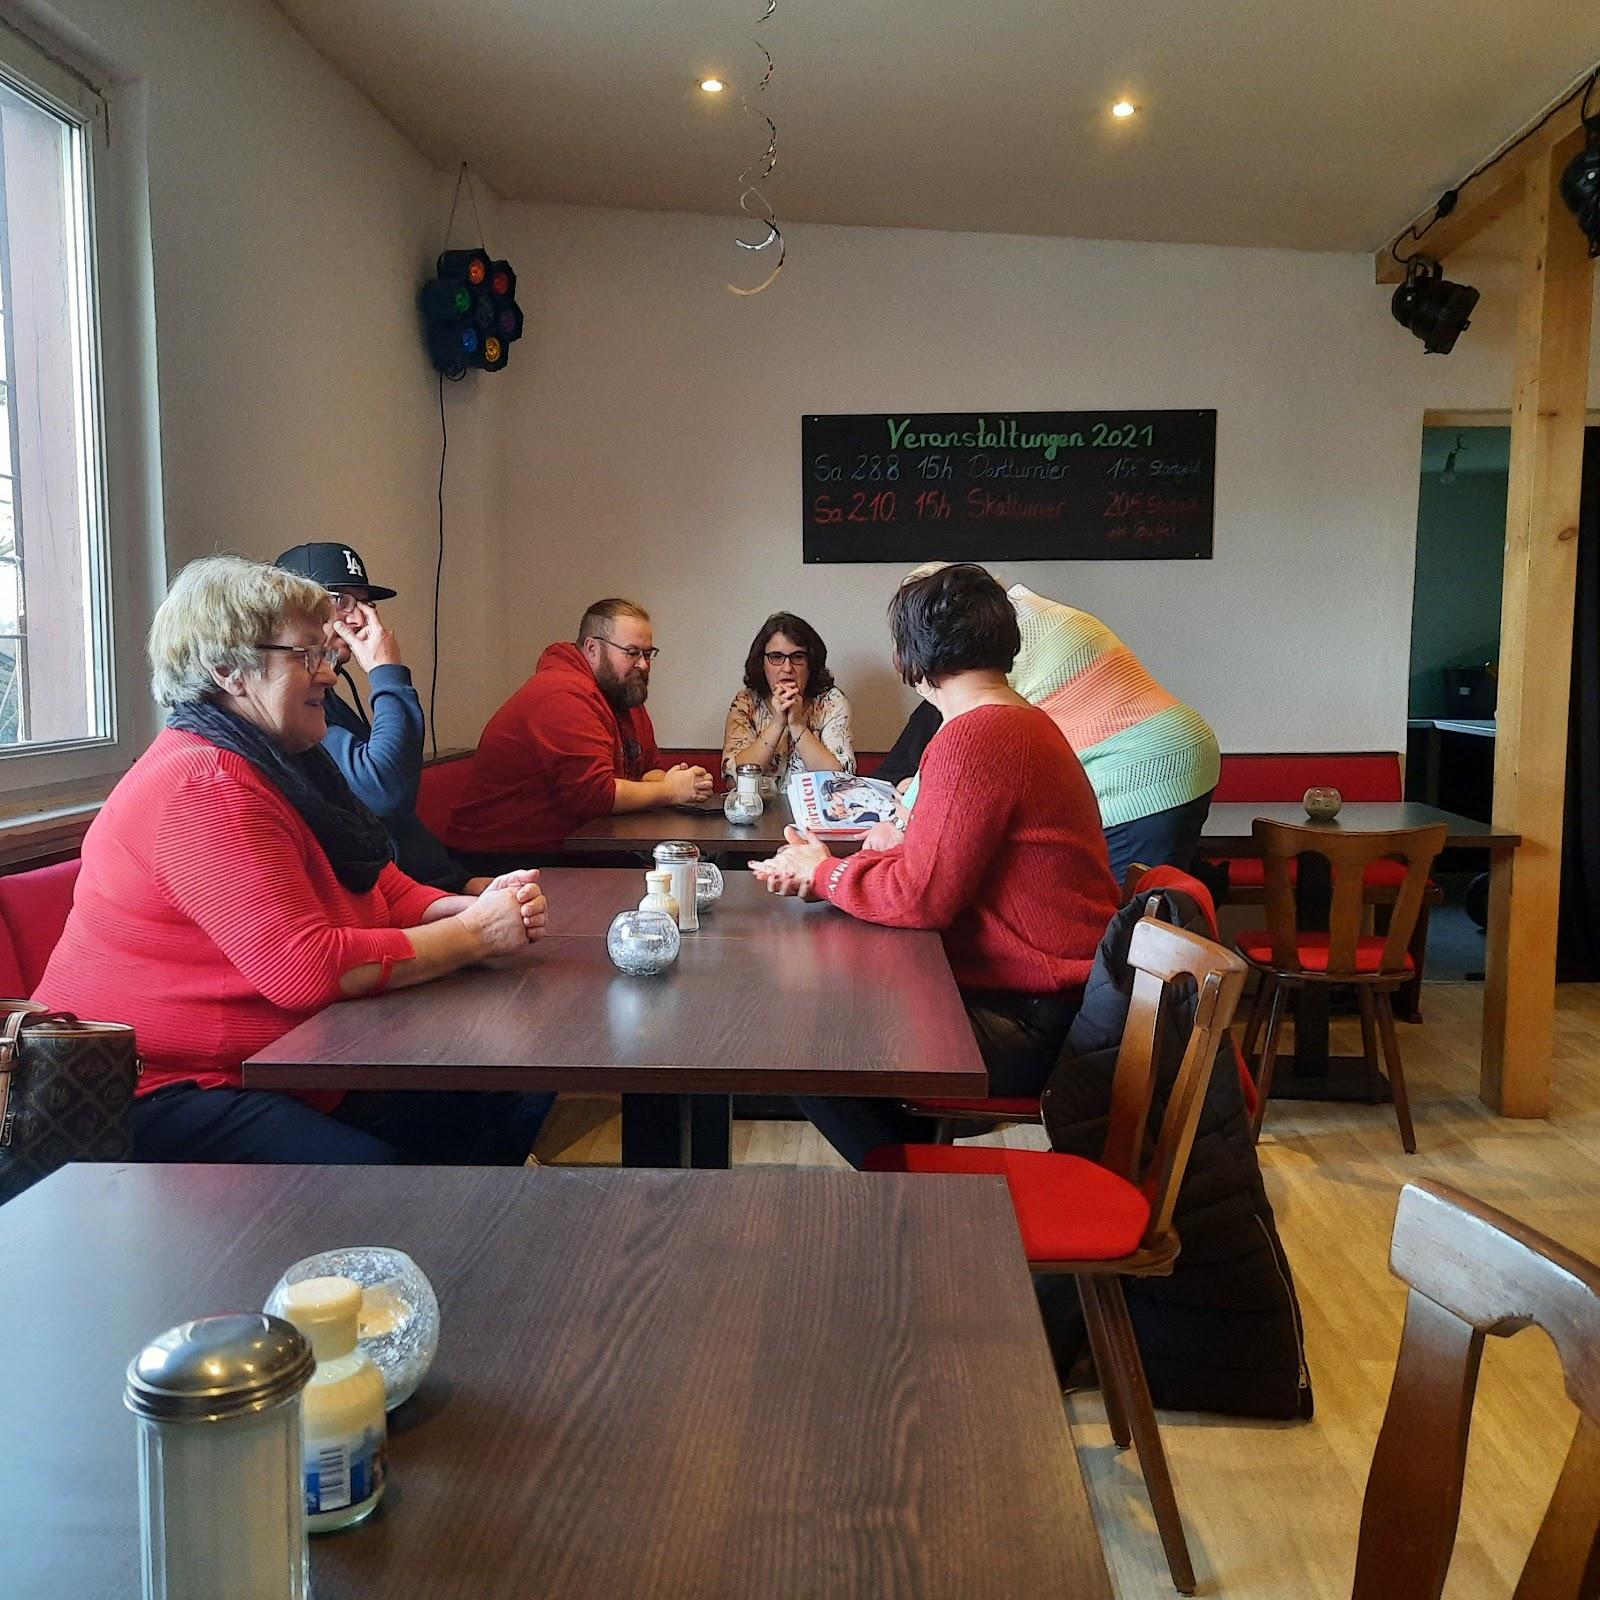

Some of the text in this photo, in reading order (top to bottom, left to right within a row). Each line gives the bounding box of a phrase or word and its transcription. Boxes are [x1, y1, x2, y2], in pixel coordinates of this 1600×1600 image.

[886, 418, 1154, 461] Veranstaltungen 2021
[814, 454, 842, 481] Sa
[917, 455, 953, 480] 15h
[814, 495, 842, 523] Sa
[915, 490, 952, 519] 15h
[343, 550, 363, 577] LA
